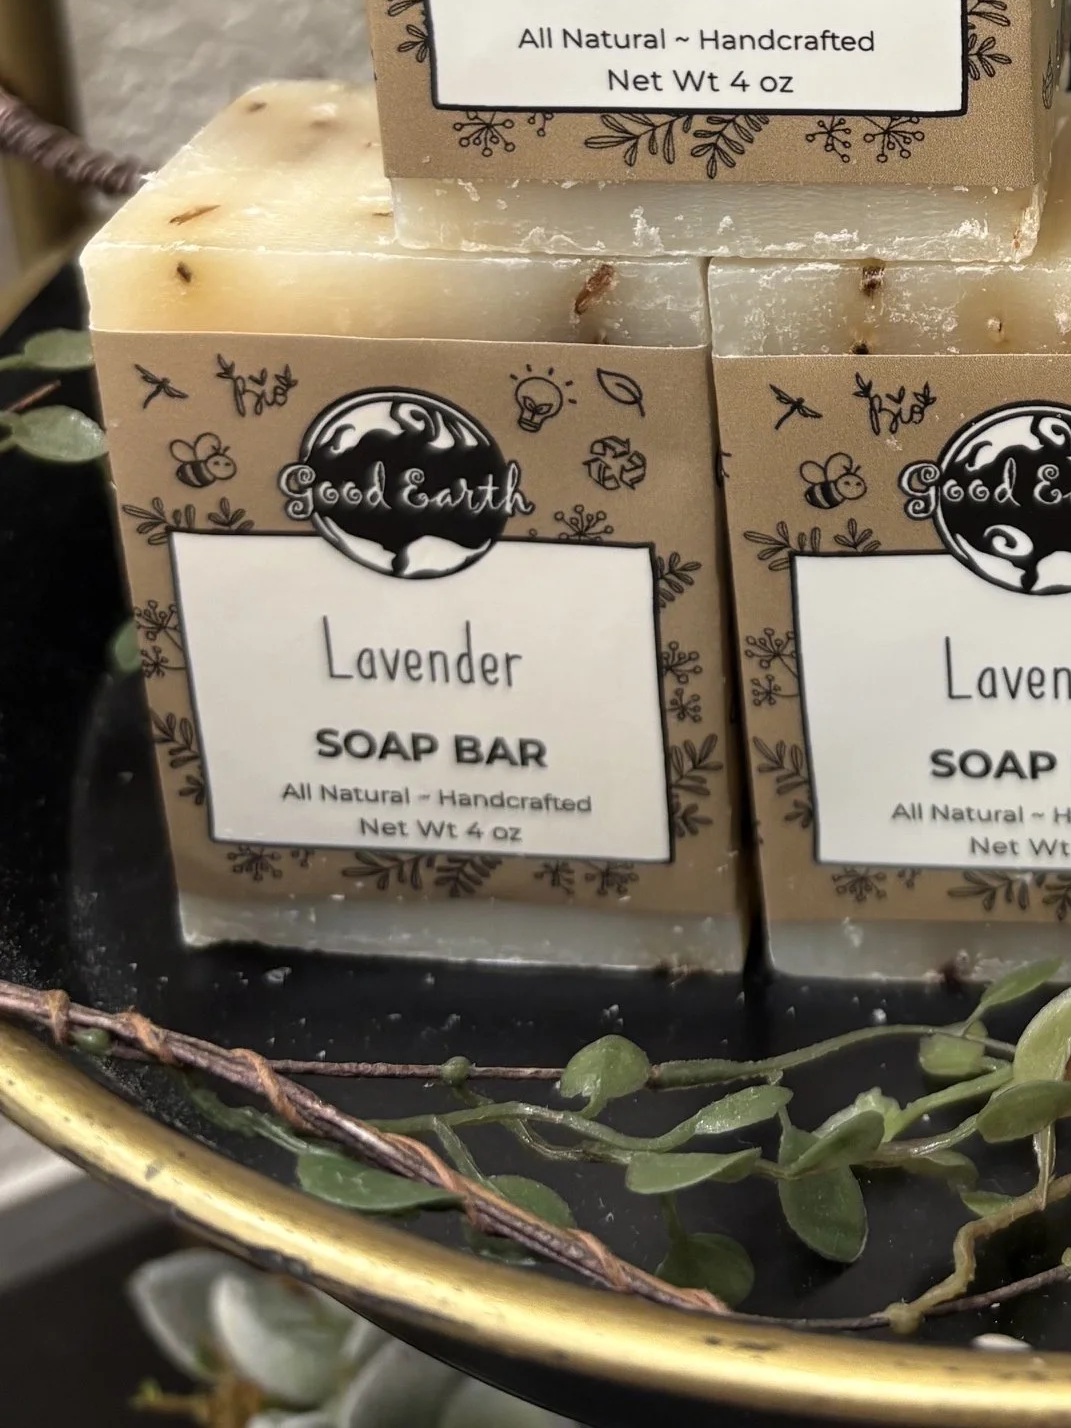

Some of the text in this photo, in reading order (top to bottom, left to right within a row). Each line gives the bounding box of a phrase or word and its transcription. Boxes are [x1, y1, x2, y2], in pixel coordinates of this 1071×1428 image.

[516, 25, 554, 50] All
[561, 26, 667, 51] Natural
[698, 27, 876, 53] Handcrafted
[606, 67, 795, 95] Net Wt 4 oz
[278, 459, 536, 521] Good Earth
[898, 456, 1021, 520] Good
[321, 614, 524, 689] Lavender
[313, 726, 550, 771] SOAP BAR
[928, 747, 1059, 783] SOAP
[278, 781, 314, 803] All
[318, 783, 412, 808] Natural
[436, 787, 594, 816] Handcrafted
[889, 801, 924, 822] All
[929, 802, 1025, 826] Natural
[357, 816, 524, 844] Net Wt 4 oz
[969, 835, 1021, 858] Net
[1027, 837, 1071, 859] Wt
